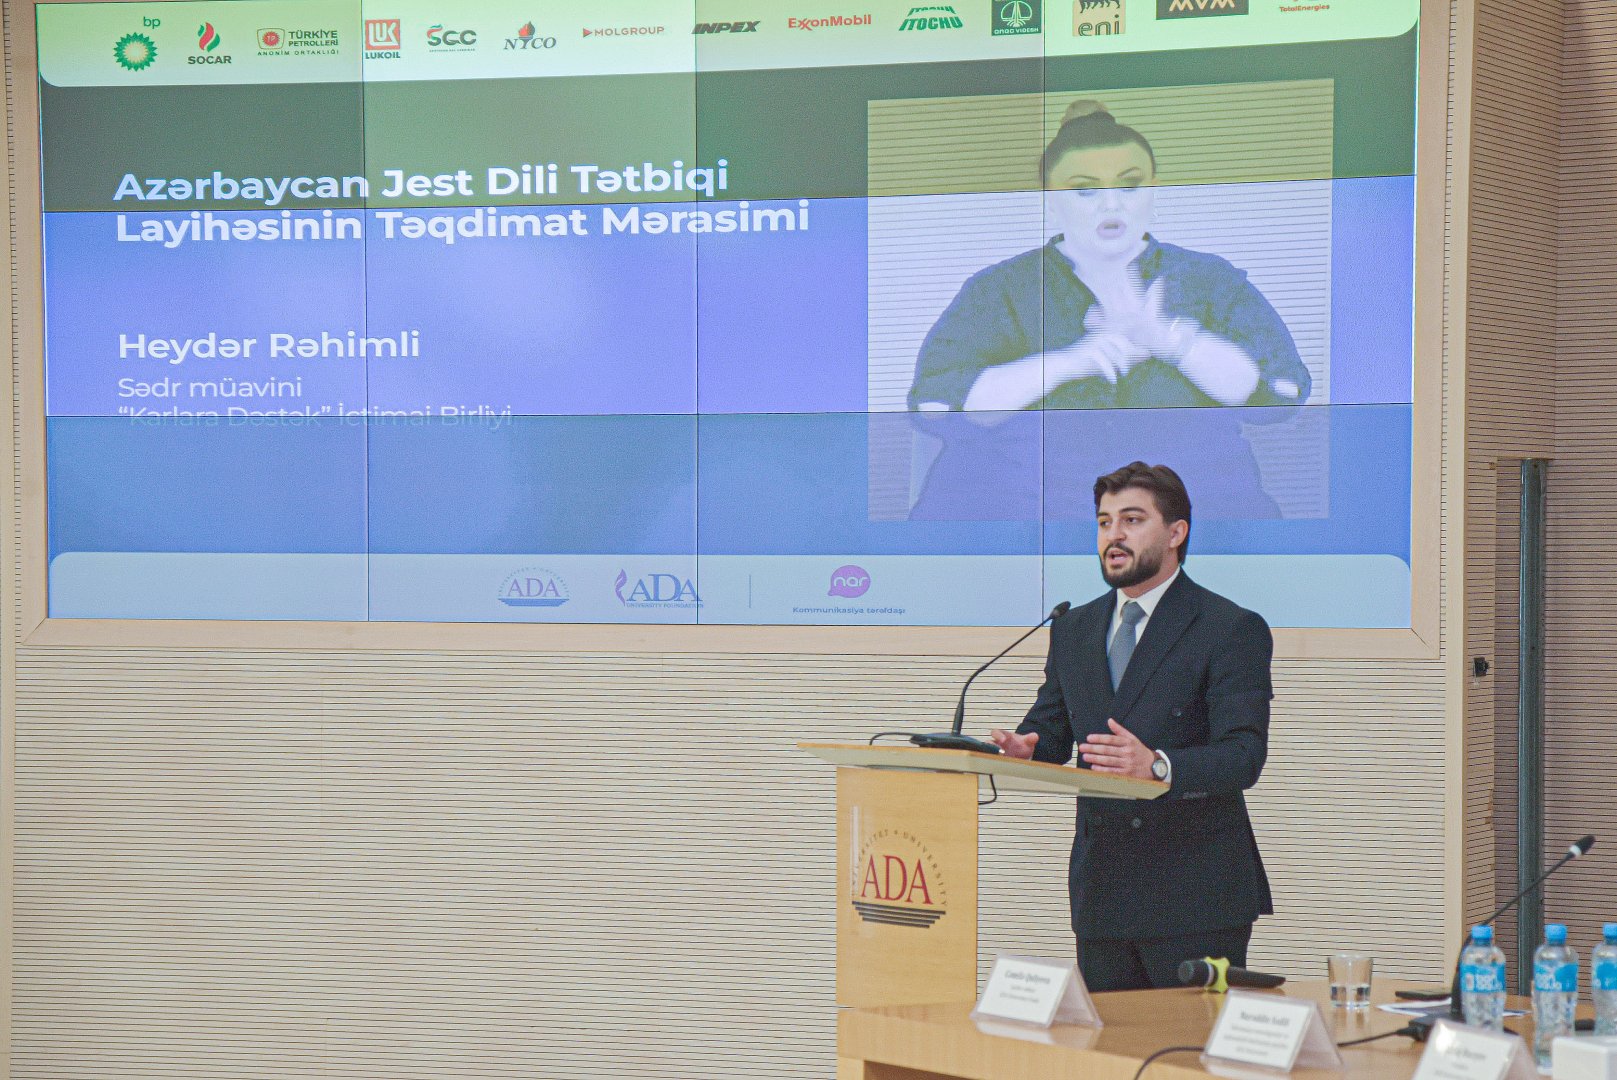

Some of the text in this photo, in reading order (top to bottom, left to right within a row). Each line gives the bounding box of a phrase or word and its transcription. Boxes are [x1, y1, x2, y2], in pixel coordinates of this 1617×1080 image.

[1279, 4, 1330, 12] TotalEnergies
[143, 16, 161, 28] bp
[691, 20, 761, 35] INPEX
[788, 14, 872, 31] ExxonMobil
[898, 16, 964, 31] ITOCHU
[1078, 14, 1120, 36] eni
[288, 29, 338, 39] TÜRKİYE
[288, 39, 339, 47] PETROLLERİ
[503, 36, 557, 50] NYCO
[187, 55, 232, 65] SOCAR
[365, 51, 401, 60] LUKOIL
[113, 158, 728, 205] Azərbaycan Jest Dili Tətbiqi
[117, 199, 809, 248] Layihəsinin Təqdimat Mərasimi
[119, 330, 420, 365] Heydər Rəhimli
[118, 376, 302, 398] Sədr müavini
[440, 404, 512, 429] Birliyi
[507, 577, 561, 597] ADA
[626, 573, 703, 602] ADA
[833, 576, 868, 587] nar
[860, 854, 934, 905] ADA
